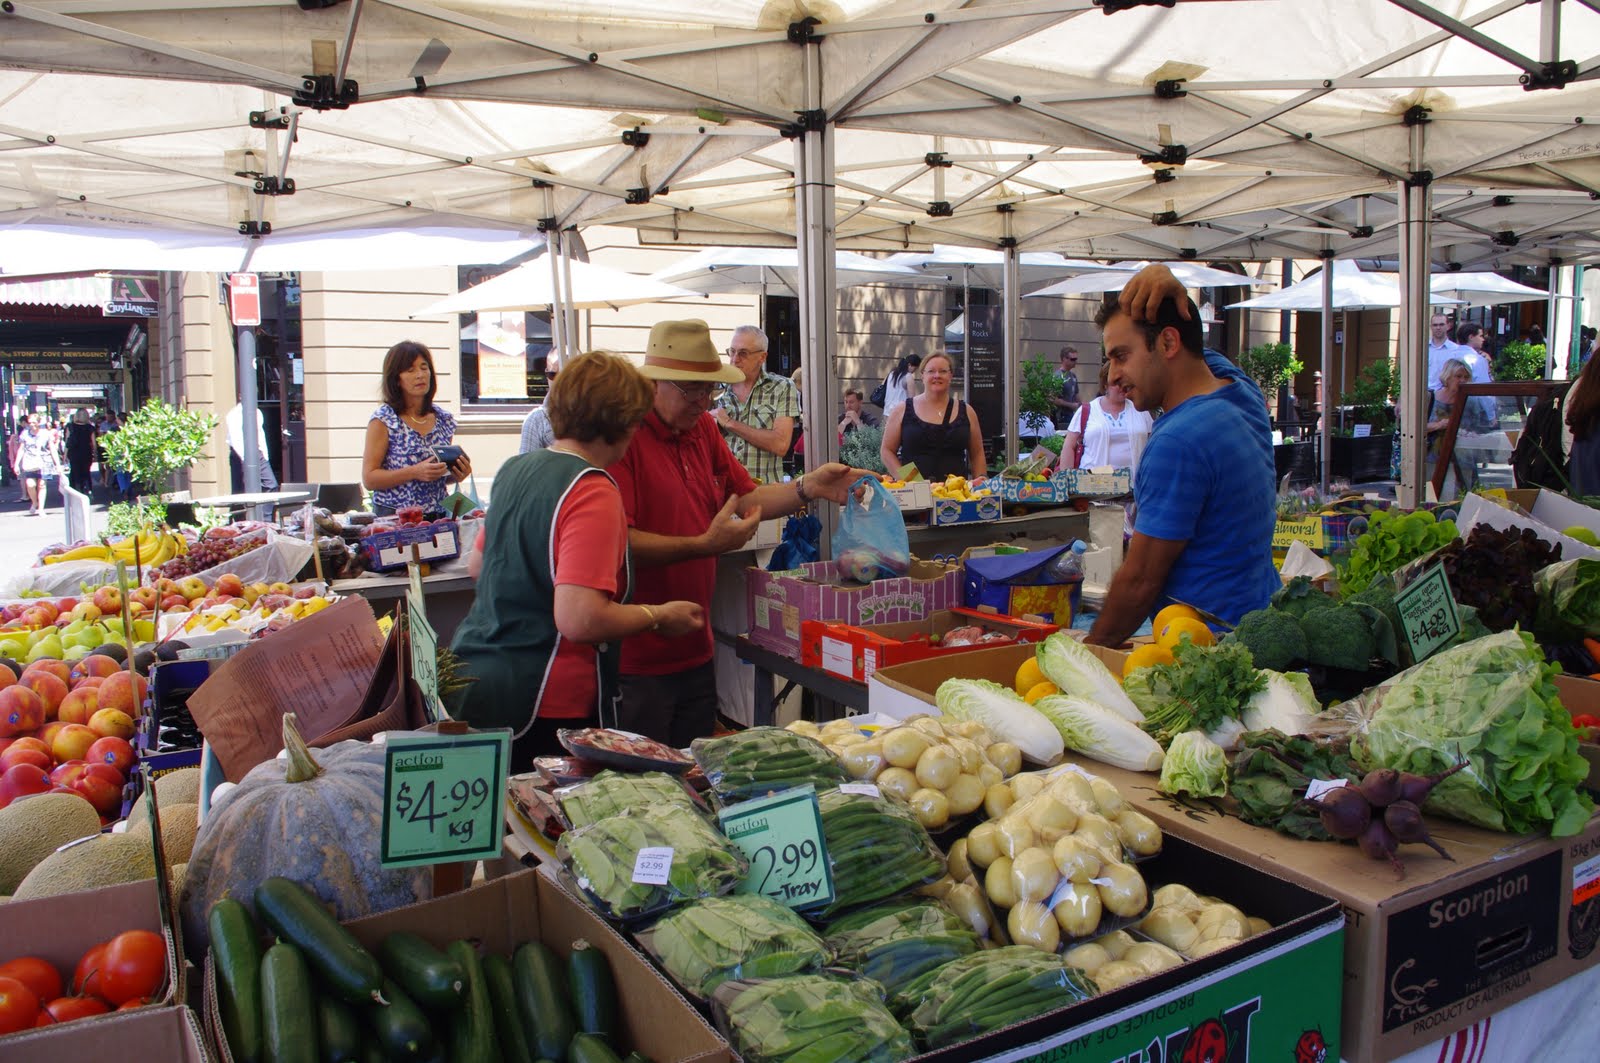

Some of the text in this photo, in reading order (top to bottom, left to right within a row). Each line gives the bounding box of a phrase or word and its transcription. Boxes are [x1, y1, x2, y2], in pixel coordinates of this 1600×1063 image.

[971, 330, 989, 338] Rocks
[37, 371, 103, 381] PHARMACY
[1274, 521, 1317, 536] almoral
[857, 591, 925, 623] Skylark
[395, 752, 444, 768] action
[728, 817, 768, 835] action
[640, 861, 664, 870] $2.99
[1429, 874, 1528, 929] Scorpion
[1412, 971, 1532, 1034] PRODUCT OF AUSTRALIA
[1126, 992, 1196, 1034] PRODUCE
[1098, 1024, 1119, 1045] OF
